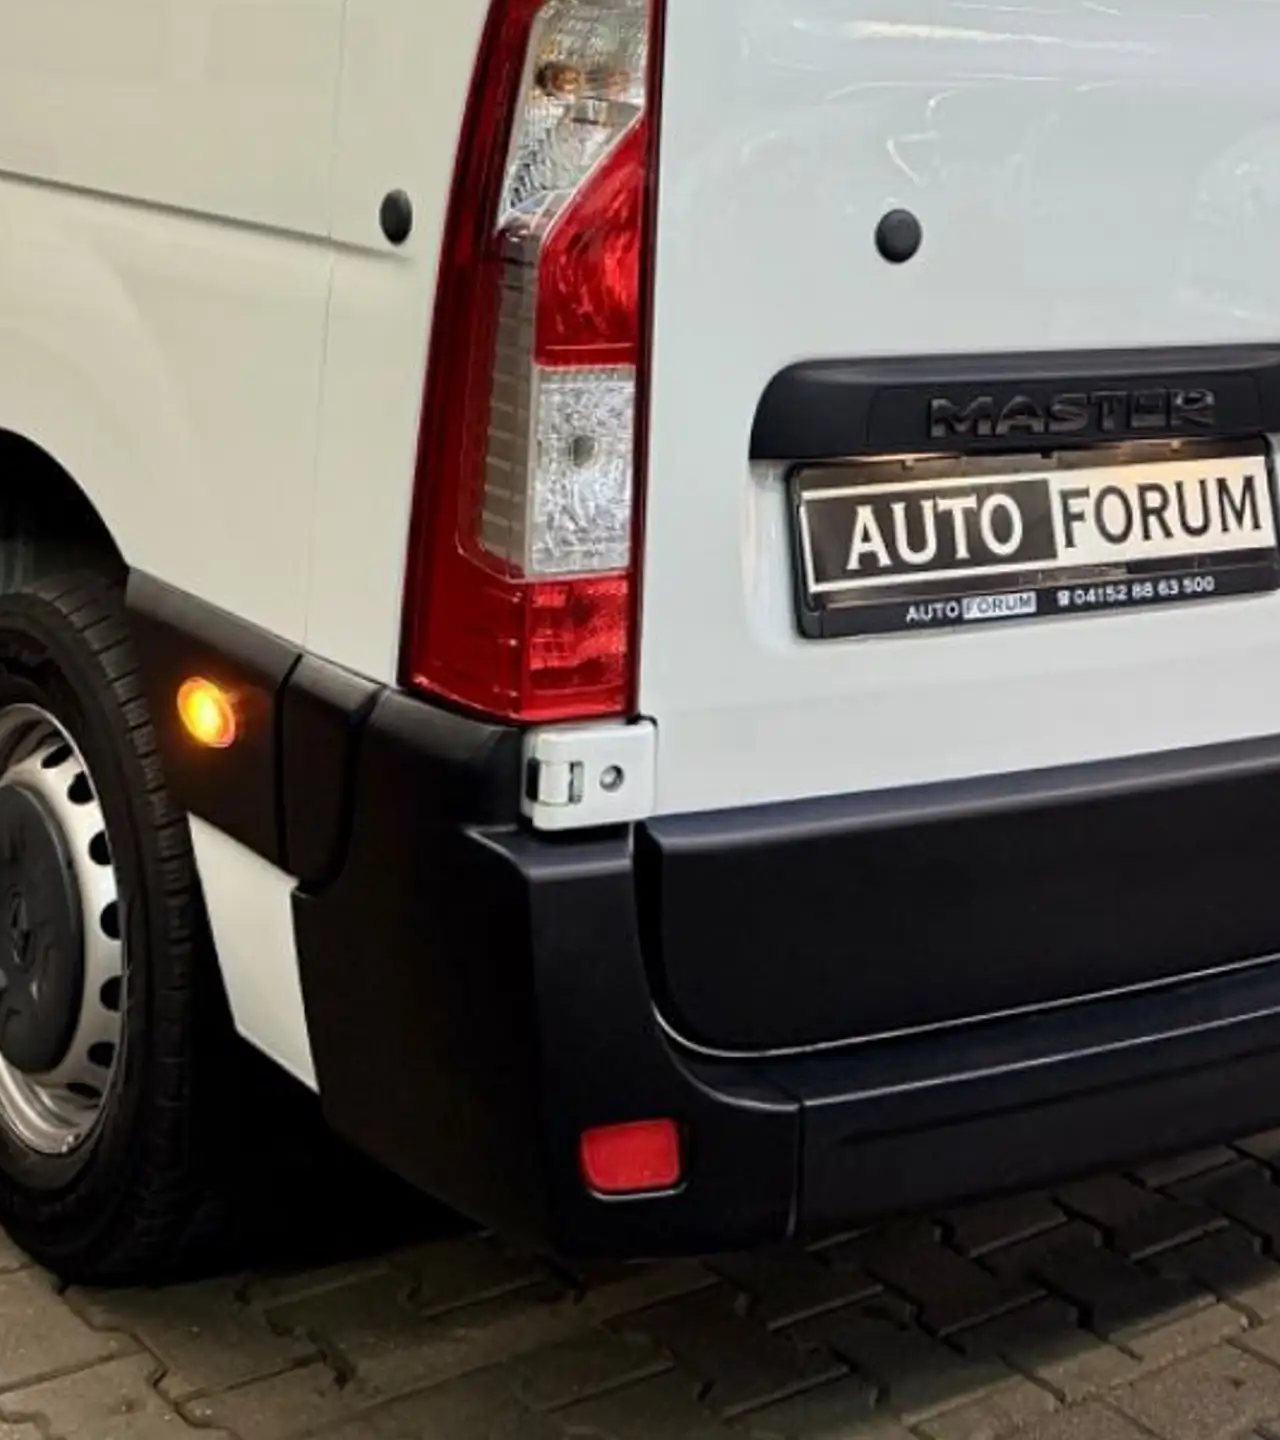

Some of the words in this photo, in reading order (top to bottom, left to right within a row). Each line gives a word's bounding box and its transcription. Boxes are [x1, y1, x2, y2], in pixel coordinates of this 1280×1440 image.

[929, 387, 1218, 439] MASTER
[846, 492, 1023, 571] AUTO
[1060, 474, 1262, 549] FORUM
[905, 600, 960, 624] AUTO
[965, 594, 1033, 616] FORUM
[1073, 582, 1128, 606] 04152
[1182, 575, 1215, 594] 500
